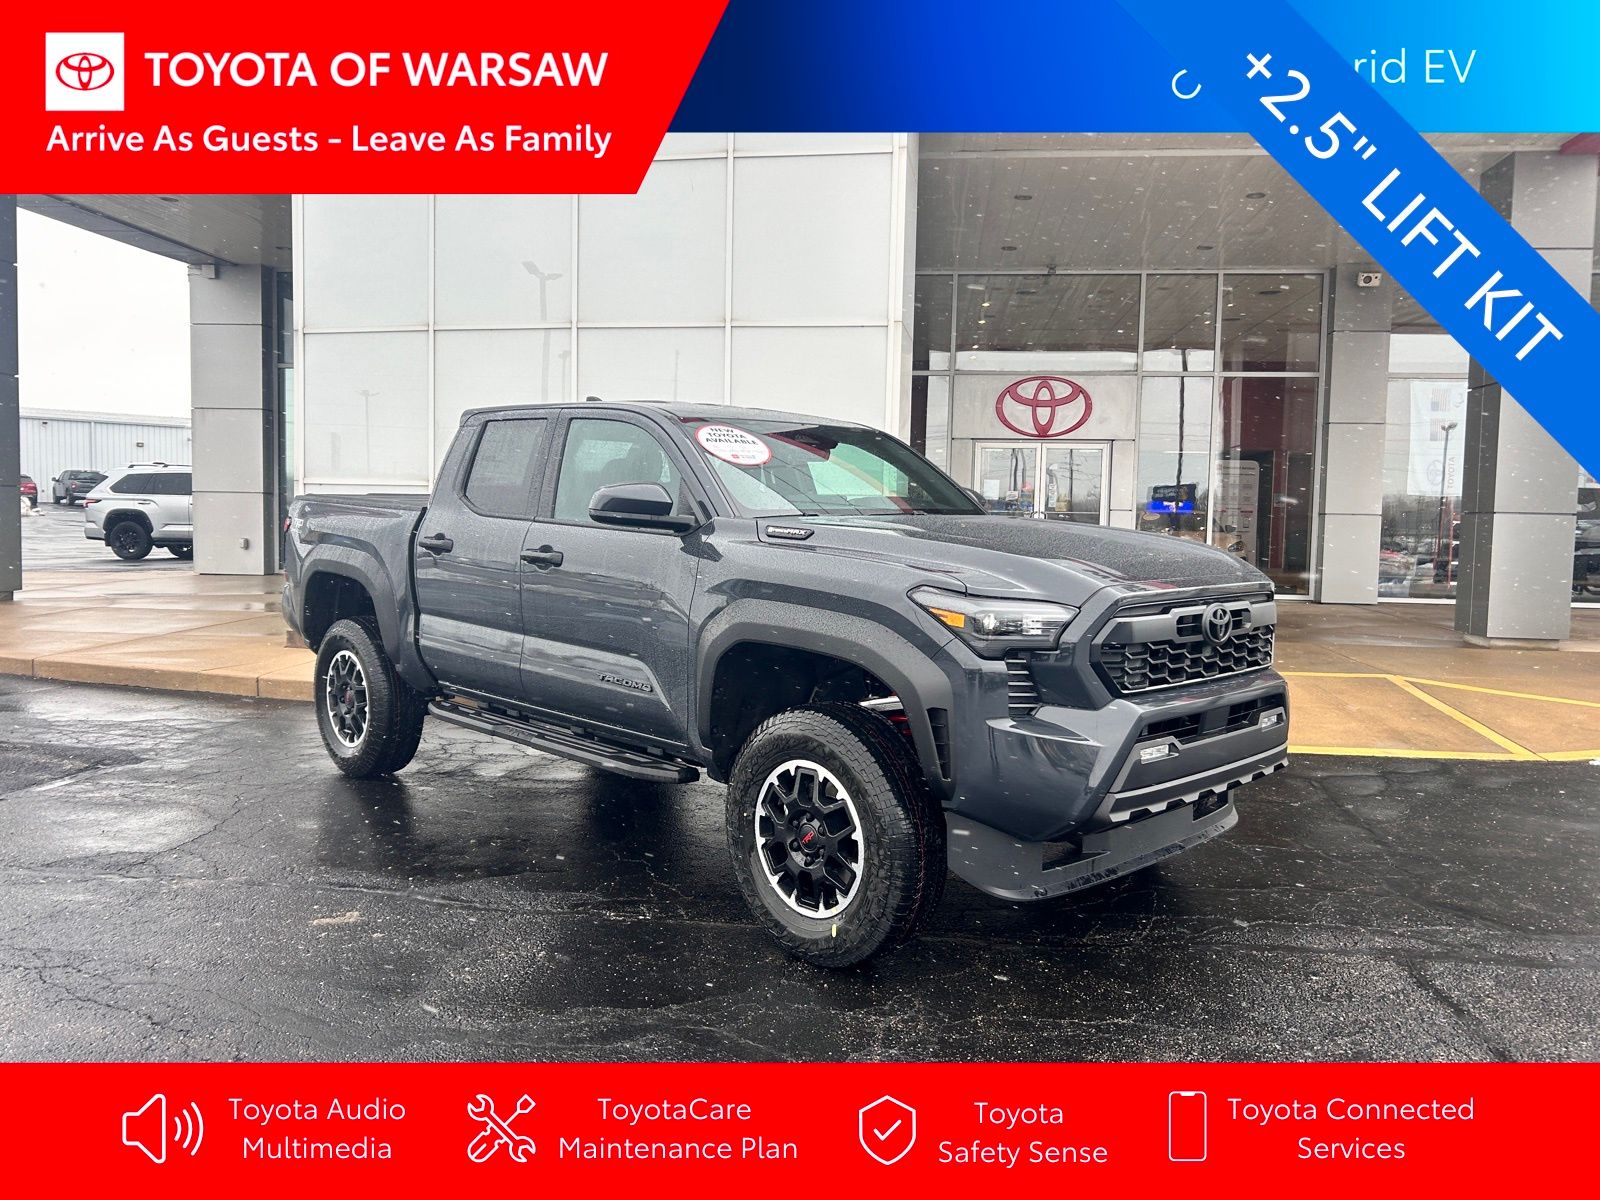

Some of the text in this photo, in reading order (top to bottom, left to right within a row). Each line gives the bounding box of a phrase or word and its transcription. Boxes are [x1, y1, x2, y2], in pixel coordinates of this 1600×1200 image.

[705, 437, 759, 446] AVAILABLE
[1447, 456, 1456, 490] TOYOTA
[597, 673, 654, 693] TACOMA
